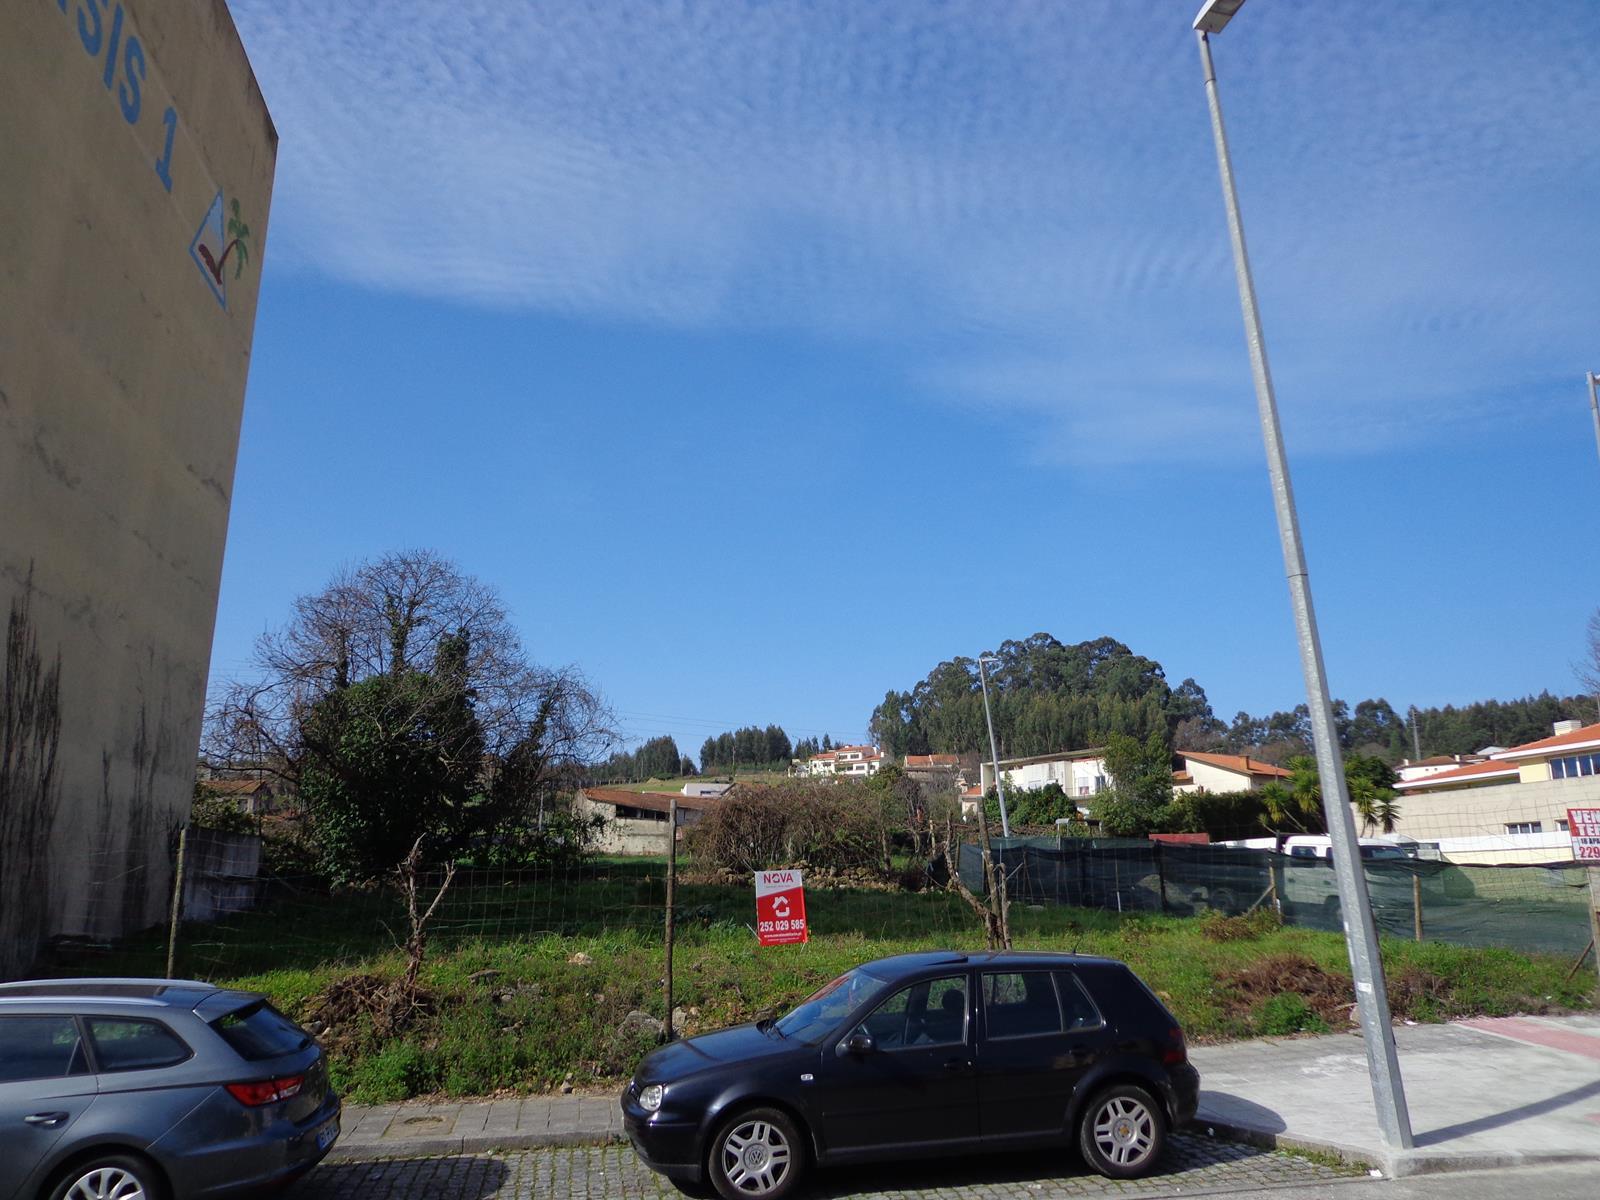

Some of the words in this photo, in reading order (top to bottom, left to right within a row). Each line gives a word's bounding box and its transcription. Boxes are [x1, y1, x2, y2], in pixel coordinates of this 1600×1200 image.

[58, 0, 146, 124] SIS
[155, 106, 177, 192] 1
[1579, 847, 1600, 858] 229
[763, 873, 793, 883] NOVA
[760, 921, 774, 932] 252
[775, 920, 789, 931] 029
[791, 919, 804, 930] 585
